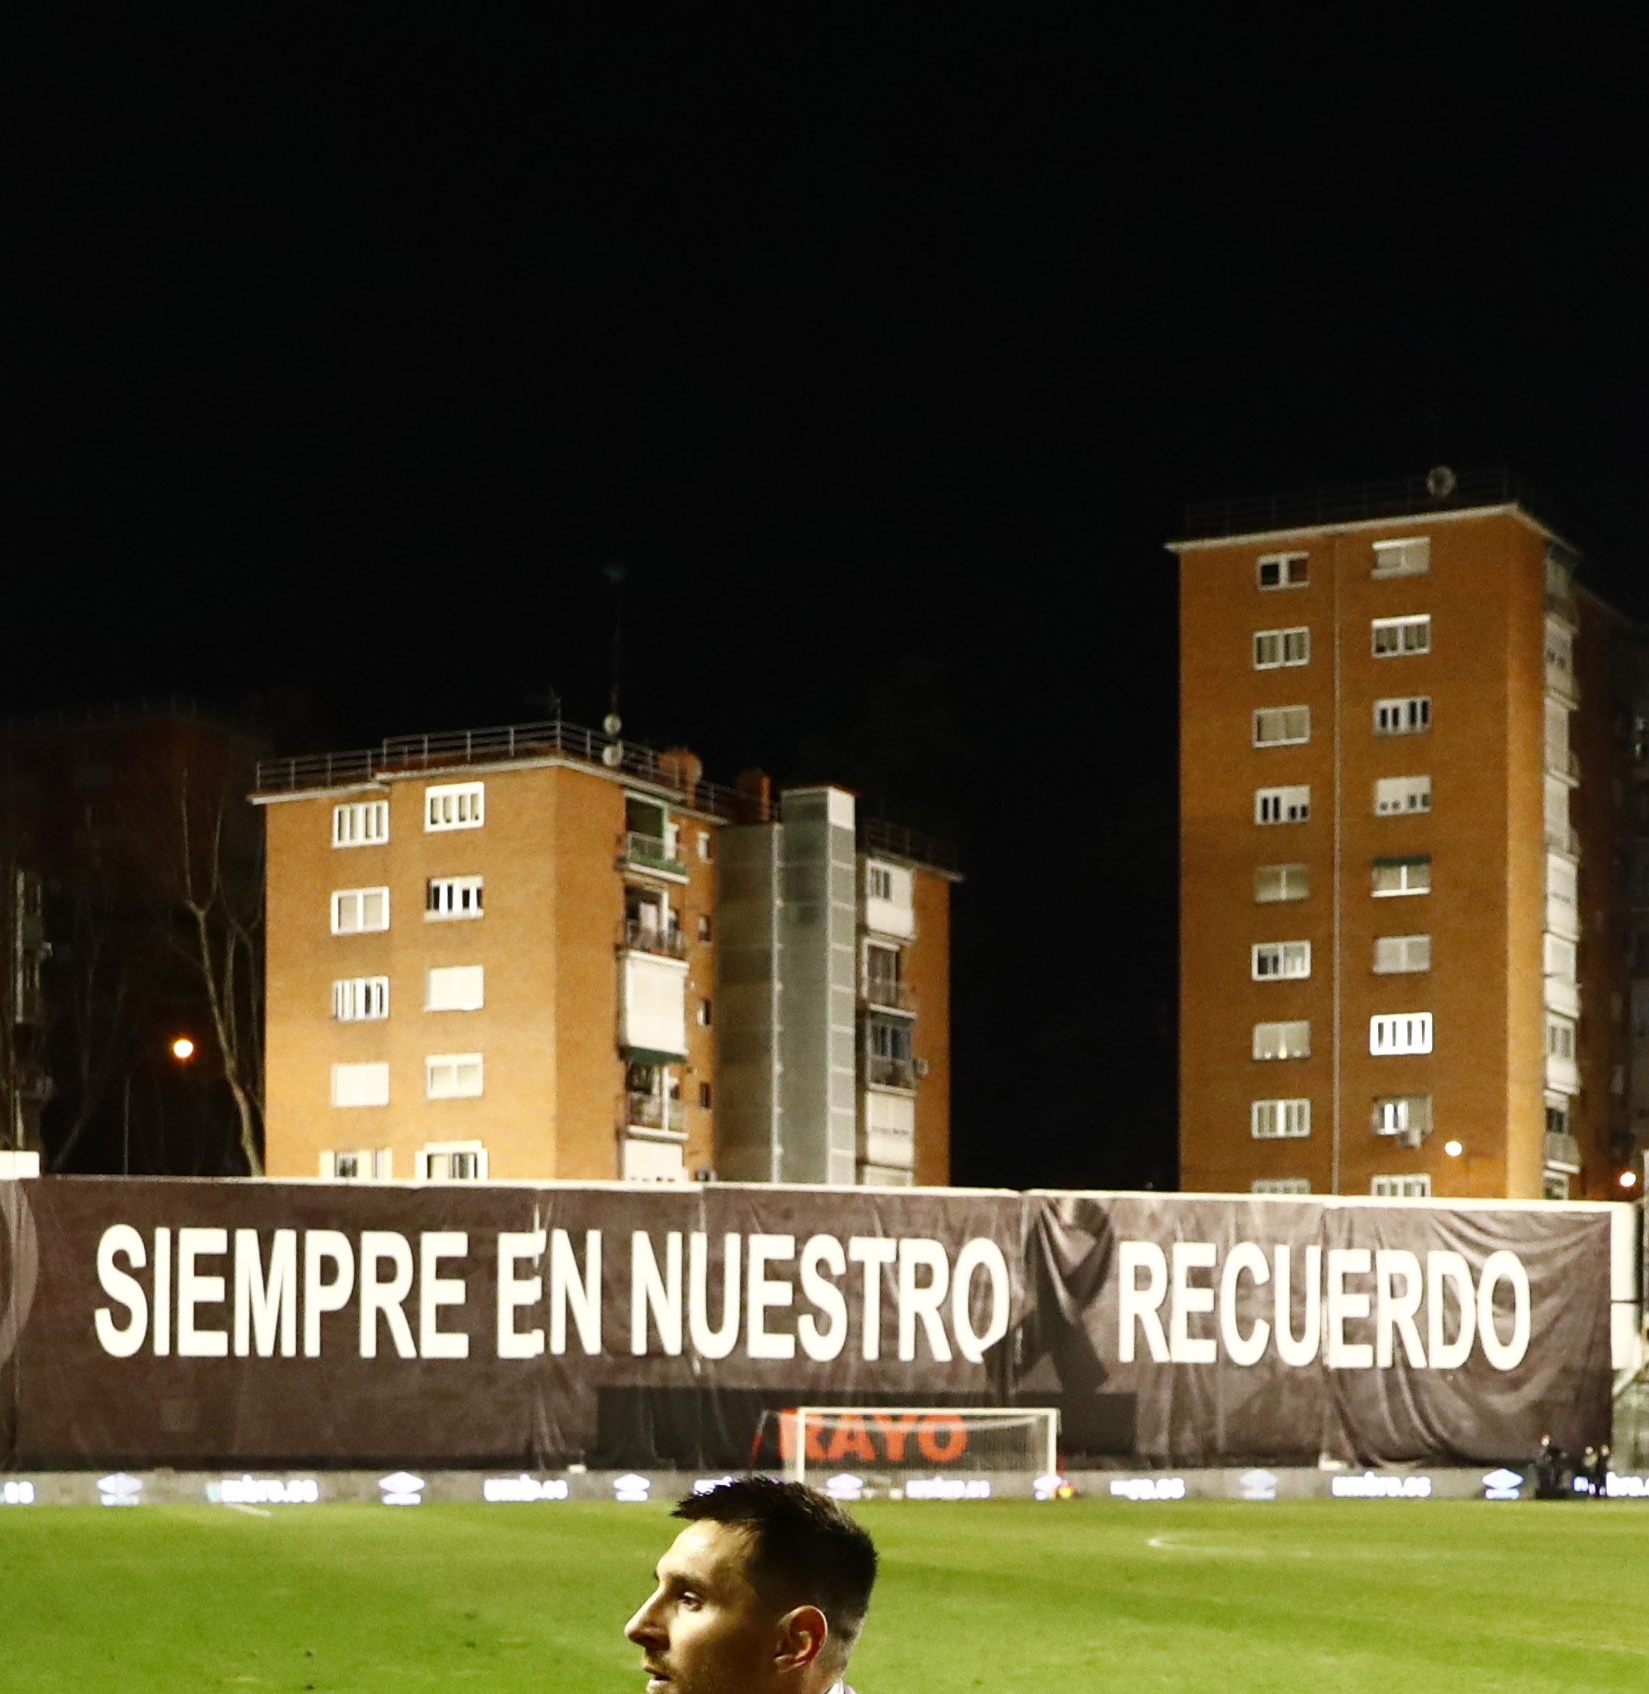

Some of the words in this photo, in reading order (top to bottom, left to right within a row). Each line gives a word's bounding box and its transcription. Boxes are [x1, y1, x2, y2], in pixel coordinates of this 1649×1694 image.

[95, 1224, 469, 1359] SIEMPRE
[496, 1229, 603, 1359] EN
[630, 1230, 1011, 1364] NUESTRO
[1118, 1240, 1533, 1371] RECUERDO
[779, 1408, 968, 1462] RAYO
